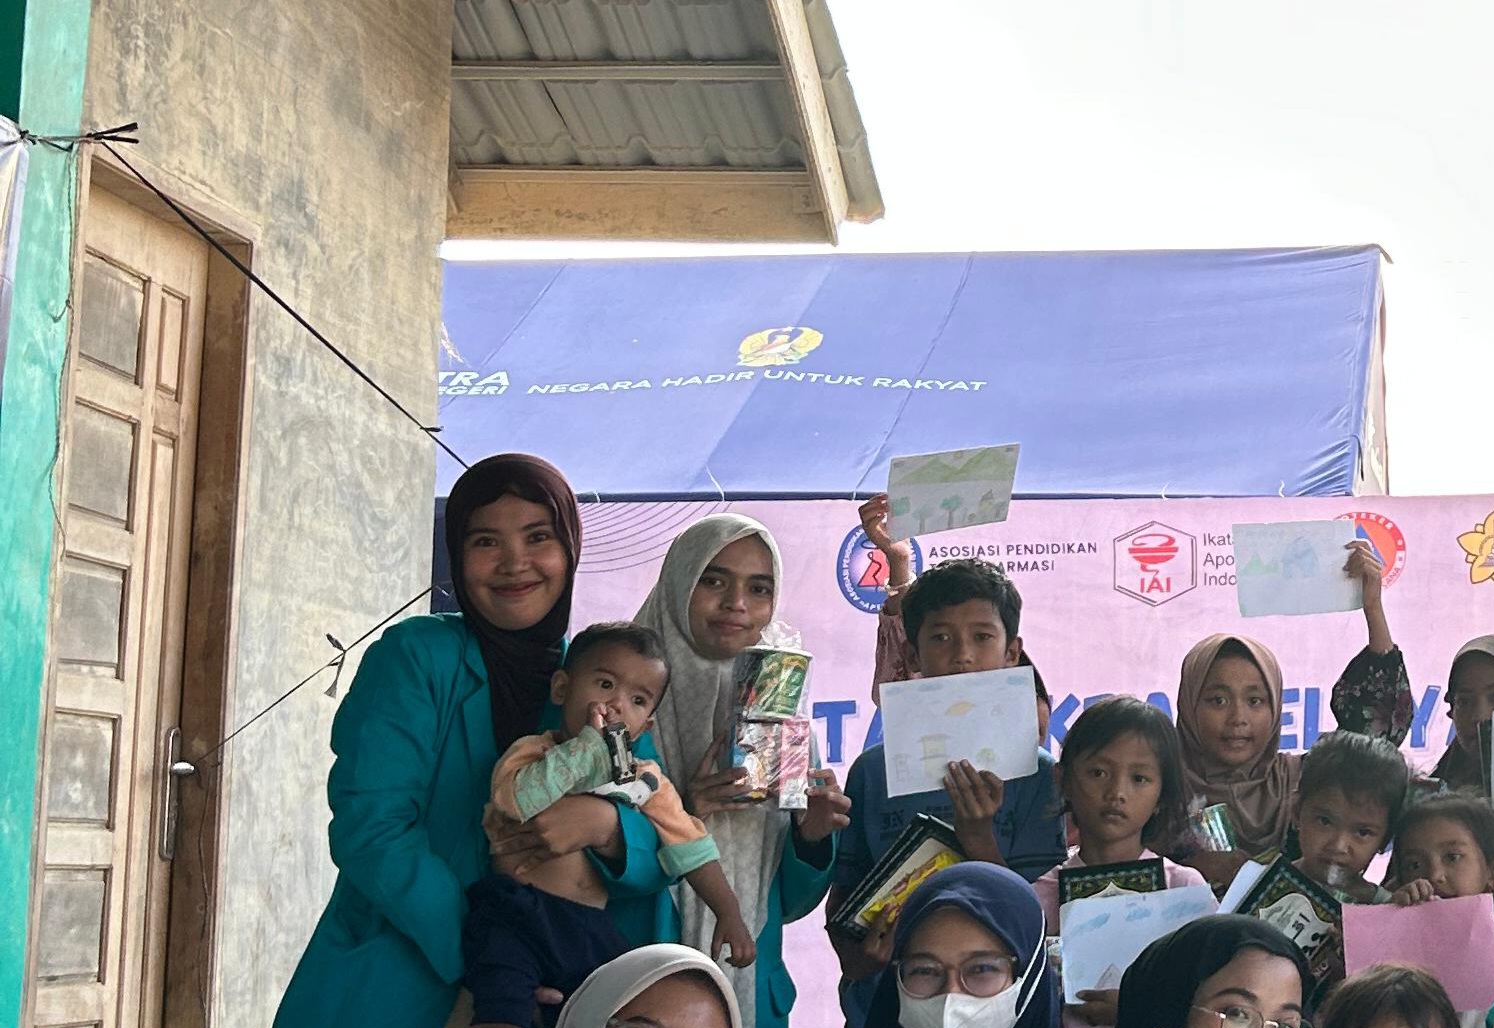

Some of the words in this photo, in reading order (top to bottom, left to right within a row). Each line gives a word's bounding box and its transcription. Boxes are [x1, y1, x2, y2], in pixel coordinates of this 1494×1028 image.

[438, 371, 510, 386] TRA
[527, 379, 652, 395] NEGARA
[661, 370, 755, 388] HADIR
[763, 369, 866, 387] UNTUK
[872, 377, 988, 392] RAKYAT
[438, 386, 508, 395] EGERI
[1203, 532, 1234, 547] Ikat
[929, 545, 1000, 558] ASOSIASI
[1006, 541, 1098, 556] PENDIDIKAN
[1140, 576, 1171, 593] IAI
